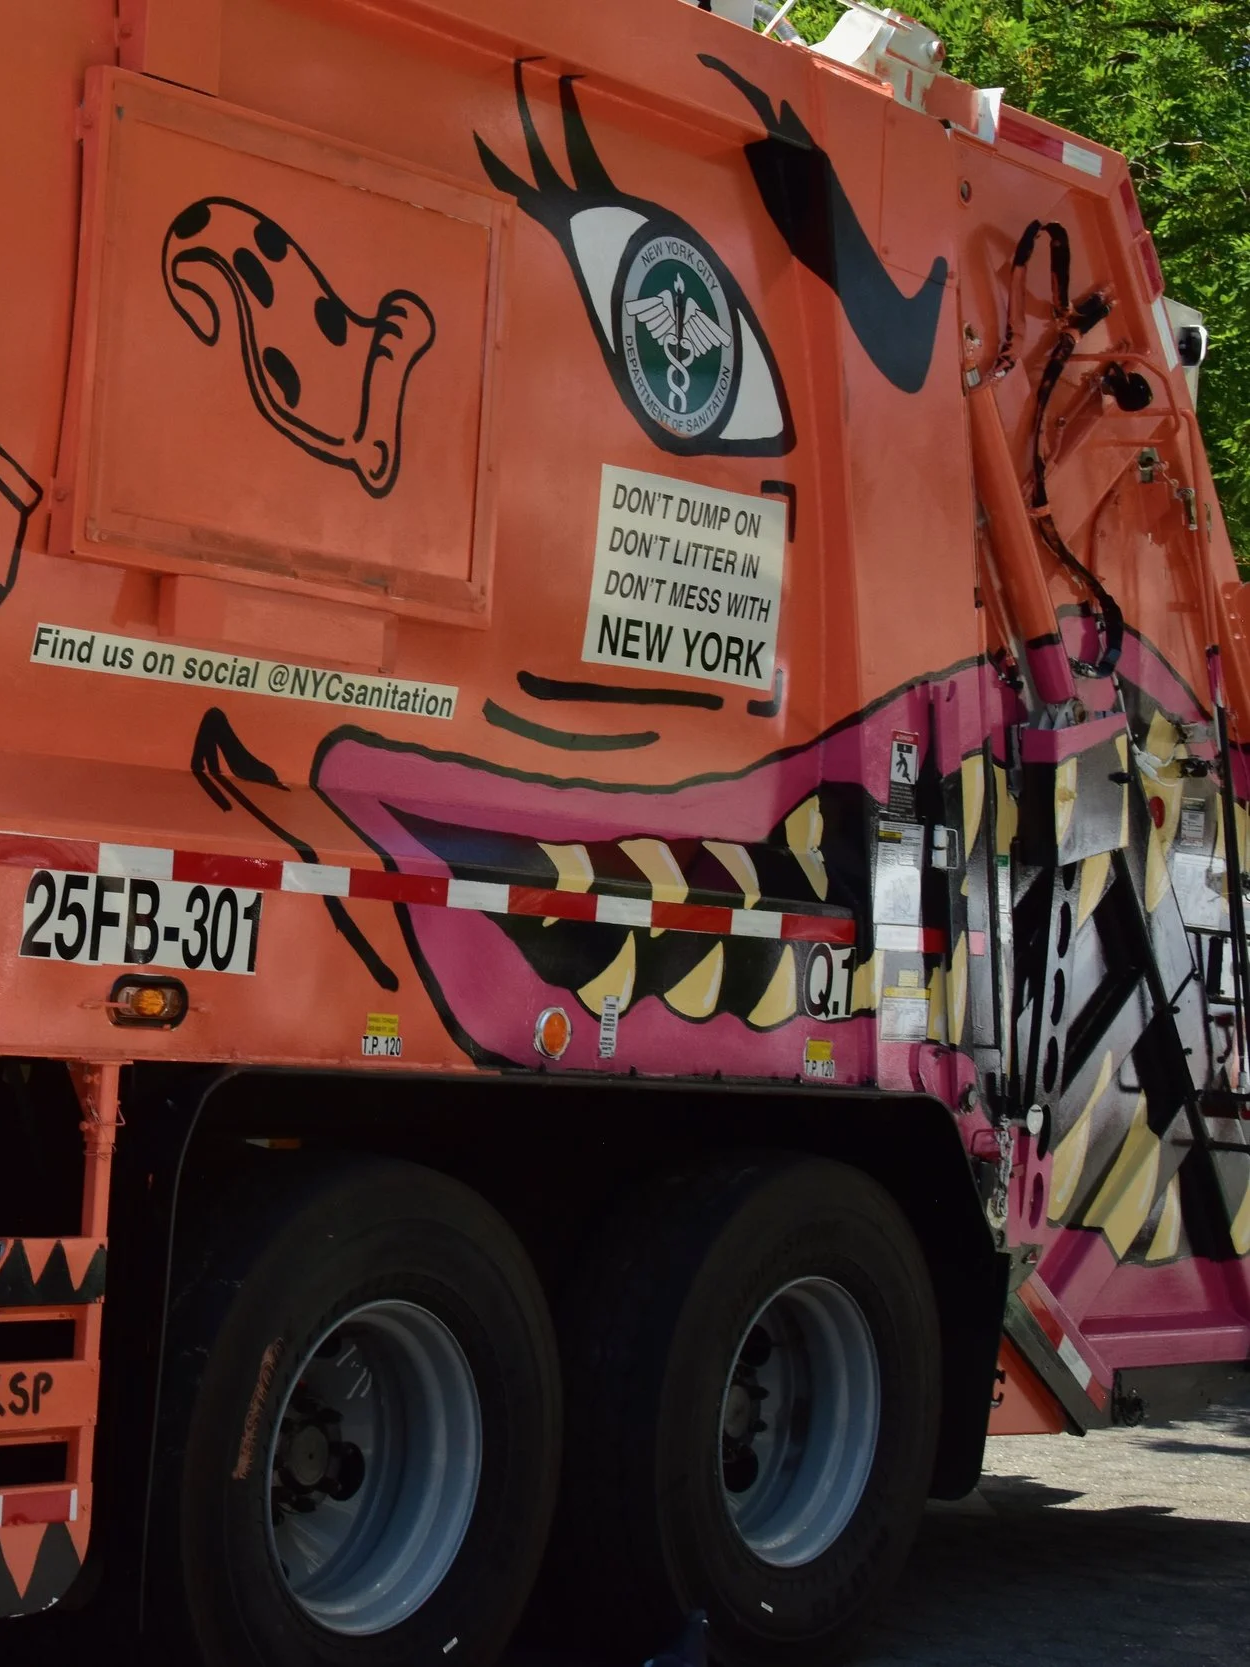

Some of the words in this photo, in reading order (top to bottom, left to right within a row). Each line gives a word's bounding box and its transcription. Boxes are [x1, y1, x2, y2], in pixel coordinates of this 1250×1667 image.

[641, 242, 663, 267] NEW
[665, 241, 694, 264] YORK
[696, 259, 719, 290] CITY
[625, 335, 671, 428] DEPARTMENT
[672, 418, 683, 432] OF
[687, 367, 730, 432] SANITATION
[612, 484, 673, 519] DON'T
[676, 498, 730, 530] DUMP
[734, 510, 761, 538] ON
[609, 527, 670, 561] DON'T
[673, 540, 738, 575] LITTER
[741, 553, 760, 579] IN
[604, 570, 666, 604] DON'T
[669, 582, 721, 614] MESS
[726, 592, 771, 623] WITH
[33, 627, 95, 664] Find
[103, 644, 134, 669] us
[143, 650, 175, 675] on
[183, 656, 260, 688] social
[268, 664, 453, 717] @NYCsanitation
[597, 615, 673, 663] NEW
[683, 627, 766, 679] YORK
[20, 870, 263, 972] 25FB-301
[363, 1036, 380, 1055] T.P.
[385, 1037, 401, 1055] 120
